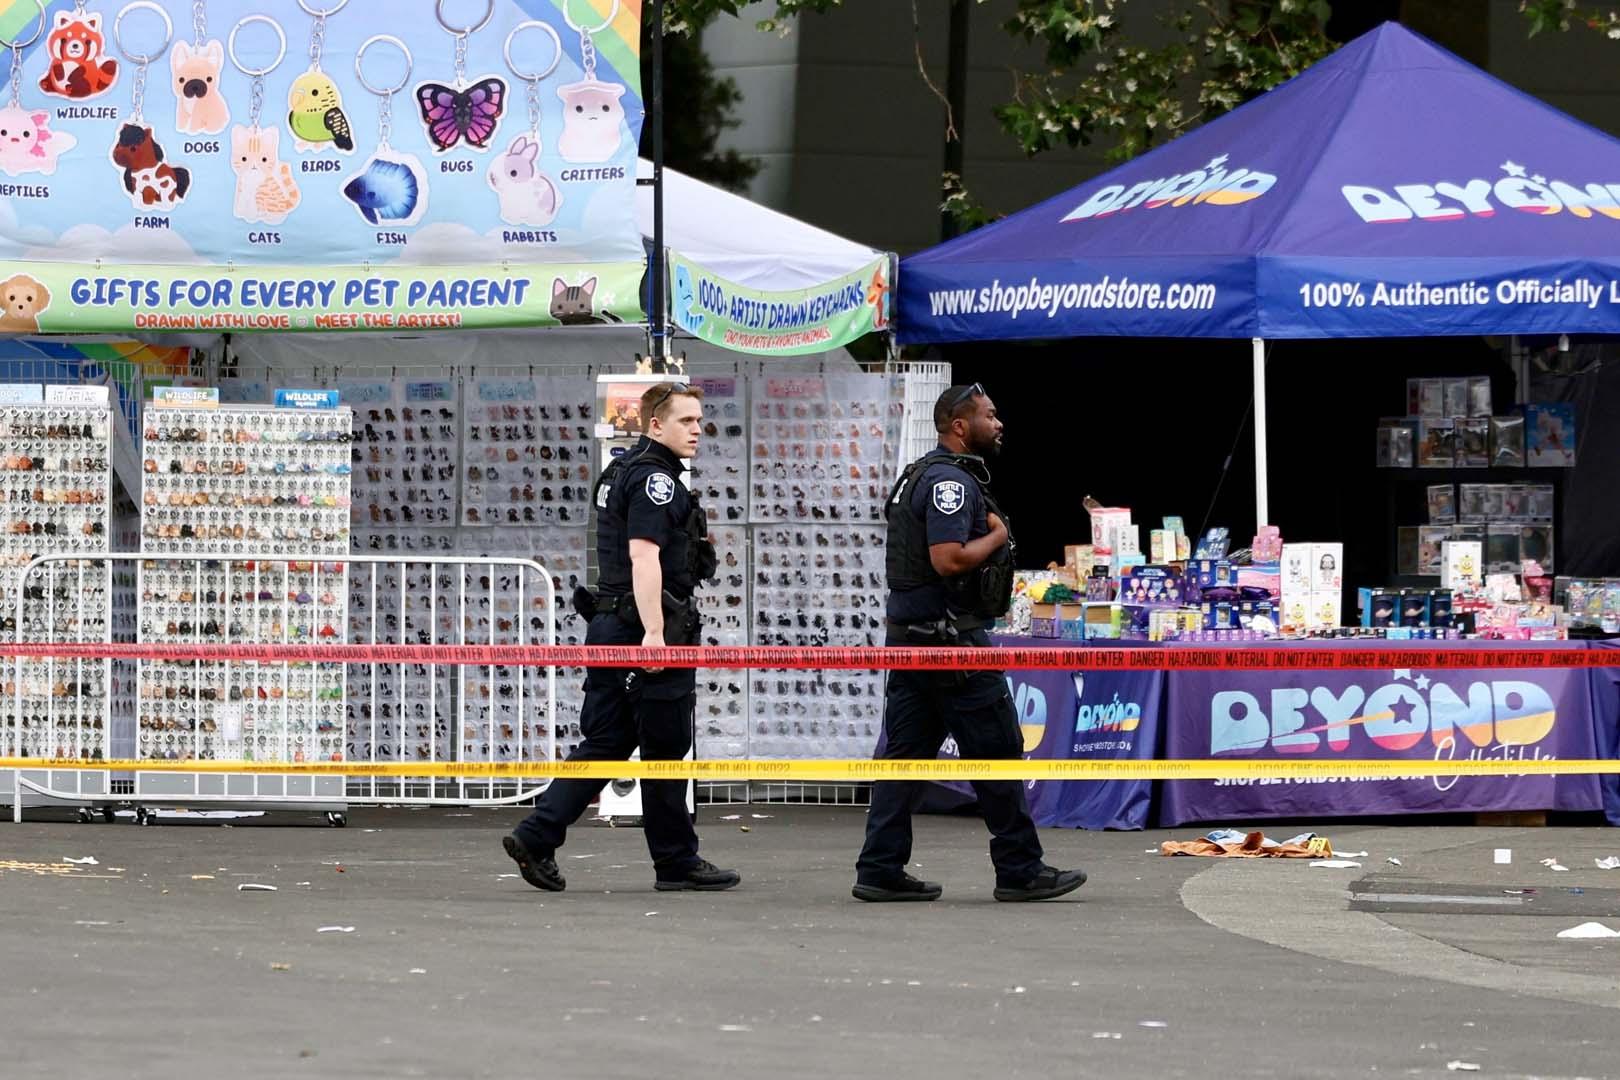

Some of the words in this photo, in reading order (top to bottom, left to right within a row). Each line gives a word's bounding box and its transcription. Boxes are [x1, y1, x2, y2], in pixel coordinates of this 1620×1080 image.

[57, 107, 117, 119] WILDLIFE
[184, 141, 220, 154] DOGS
[301, 160, 341, 172] BIRDS
[440, 160, 474, 173] BUGS
[560, 167, 625, 181] CRITTERS
[1058, 165, 1277, 224] BEYOND
[1341, 177, 1620, 223] BEYON
[134, 216, 170, 229] FARM
[248, 231, 281, 244] CATS
[376, 232, 407, 245] FISH
[502, 230, 557, 243] RABBITS
[71, 278, 160, 306] GIFTS
[169, 279, 232, 307] FOR
[241, 280, 335, 307] EVERY
[344, 279, 399, 305] PET
[408, 279, 528, 305] PARENT
[928, 276, 1217, 319] www.shopbeyondstore.com
[1299, 282, 1366, 307] 100%
[1371, 281, 1489, 306] Authentic
[1496, 279, 1603, 309] Officially
[699, 277, 727, 317] 1000+
[730, 296, 768, 329] ARTIST
[768, 302, 806, 329] DRAWN
[808, 280, 865, 324] KEYCHAINS
[136, 316, 195, 328] DRAWN
[200, 315, 244, 328] WITH
[249, 316, 289, 328] LOVE
[315, 315, 356, 328] MEET
[361, 315, 392, 328] THE
[394, 315, 462, 328] ARTIST!
[165, 391, 208, 400] WILDLIFE
[285, 392, 328, 401] WILDLIFE
[455, 649, 484, 661] ENTER
[587, 649, 632, 663] MATERIAL
[636, 649, 648, 663] DO
[650, 649, 668, 663] NOT
[671, 649, 698, 663] ENTER
[705, 649, 740, 664] DANGER
[744, 650, 798, 665] HAZARDOUS
[802, 650, 847, 665] MATERIAL
[850, 650, 863, 665] DO
[864, 650, 882, 665] NOT
[884, 650, 912, 665] ENTER
[919, 651, 953, 666] DANGER
[957, 651, 1009, 666] HAZARDOUS
[1014, 651, 1057, 666] MATERIAL
[1062, 651, 1075, 666] DO
[1076, 651, 1093, 666] NOT
[1096, 651, 1124, 667] ENTER
[1130, 651, 1165, 667] DANGER
[1168, 651, 1220, 667] HAZARDOUS
[1225, 651, 1268, 667] MATERIAL
[1273, 651, 1286, 667] DO
[1287, 651, 1306, 667] NOT
[1306, 652, 1334, 667] ENTER
[1340, 652, 1376, 667] DANGER
[1378, 652, 1431, 667] HAZARDOUS
[1434, 652, 1479, 667] MATERIAL
[1483, 652, 1496, 667] DO
[1497, 652, 1516, 667] NOT
[1516, 652, 1544, 666] ENTER
[1551, 652, 1585, 666] DANGER
[1075, 702, 1141, 733] BEYOND
[1211, 681, 1555, 755] BEYOND
